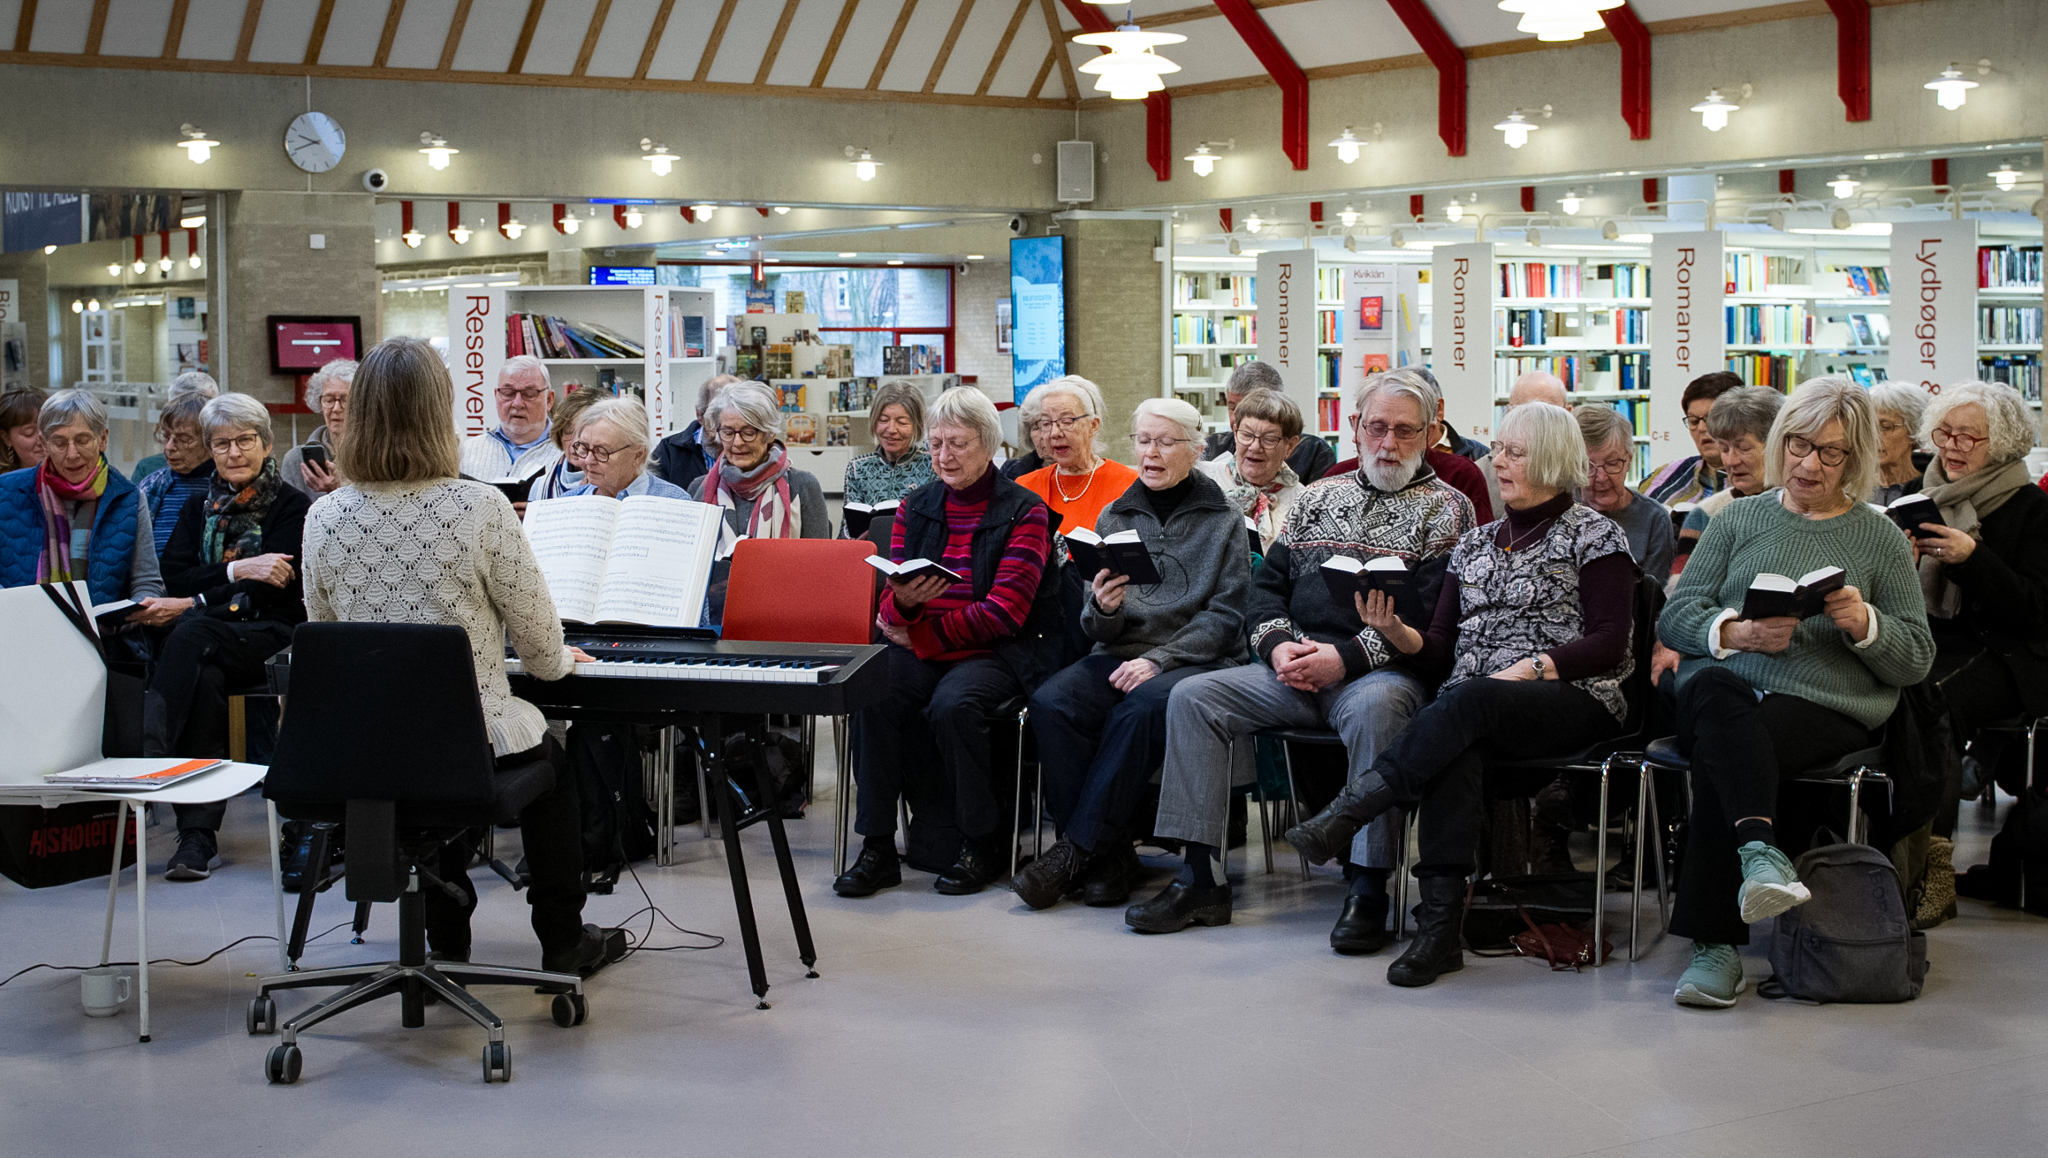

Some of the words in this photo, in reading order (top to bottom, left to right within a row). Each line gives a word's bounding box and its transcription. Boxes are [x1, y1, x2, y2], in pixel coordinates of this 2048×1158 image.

[1279, 263, 1291, 368] Romaner
[1453, 258, 1469, 371] Romaner
[1677, 248, 1695, 372] Romaner
[1915, 238, 1942, 370] Lydbøger
[1920, 380, 1941, 396] &
